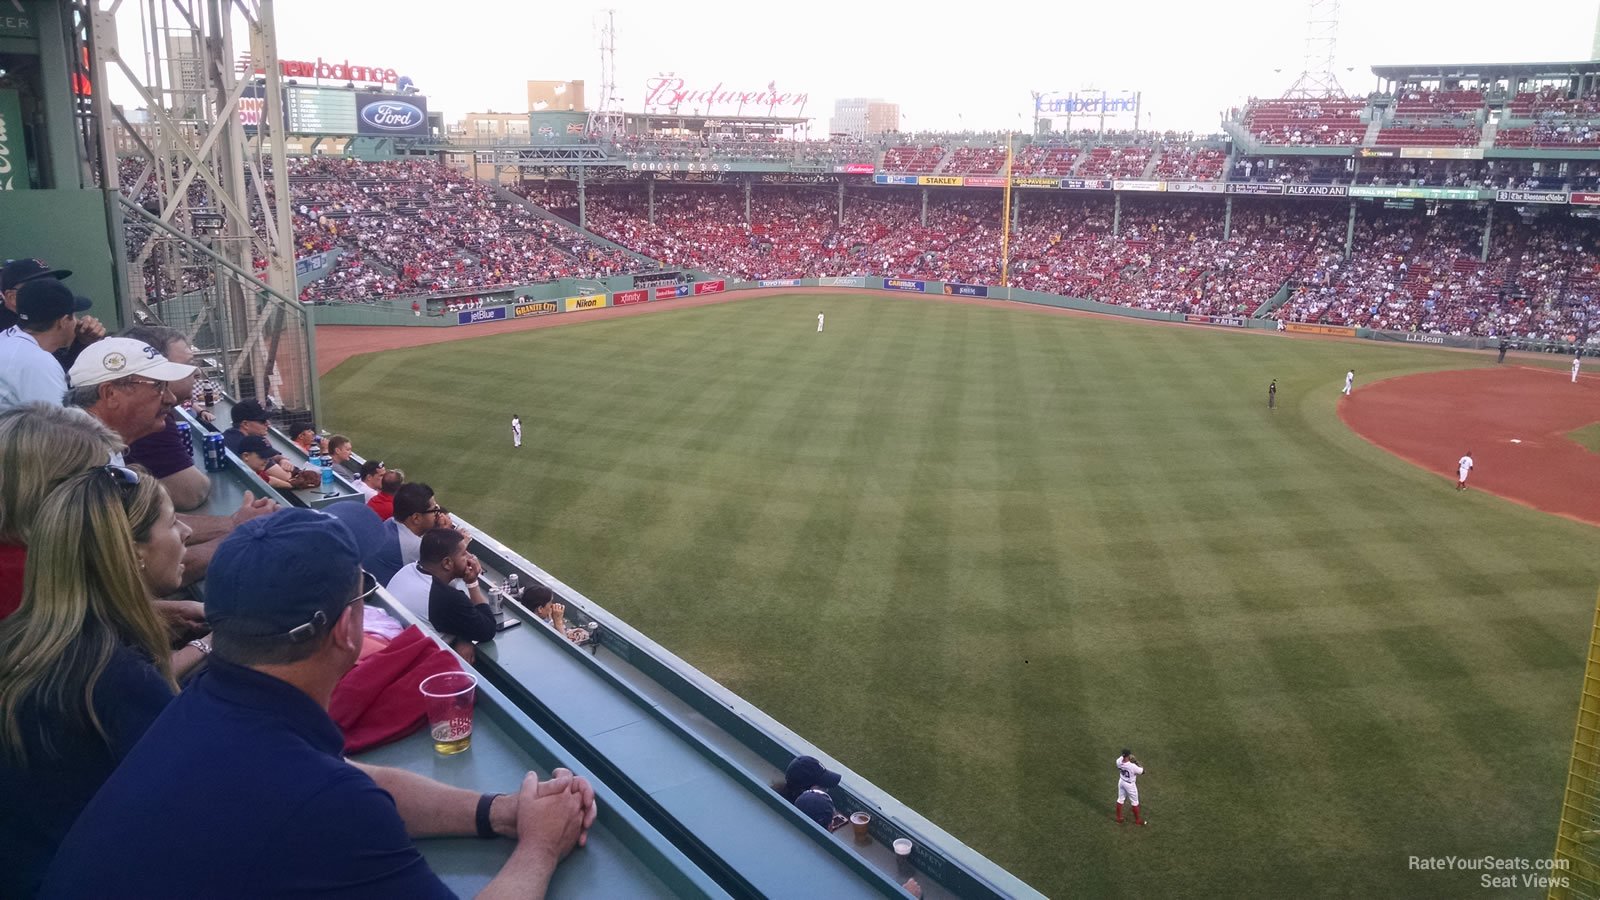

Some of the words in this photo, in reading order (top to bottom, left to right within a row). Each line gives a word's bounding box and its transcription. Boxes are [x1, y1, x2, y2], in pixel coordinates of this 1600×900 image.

[278, 60, 315, 77] new
[317, 57, 399, 84] balance
[645, 77, 808, 106] Budweiser
[1035, 91, 1136, 112] Cumberland
[374, 104, 412, 125] Ford
[575, 298, 597, 309] Nikon
[620, 293, 641, 304] xfinity
[471, 309, 495, 322] jetBlue
[516, 303, 542, 316] GRANITE
[543, 302, 557, 312] CITY
[1406, 334, 1444, 344] L.L.Bean
